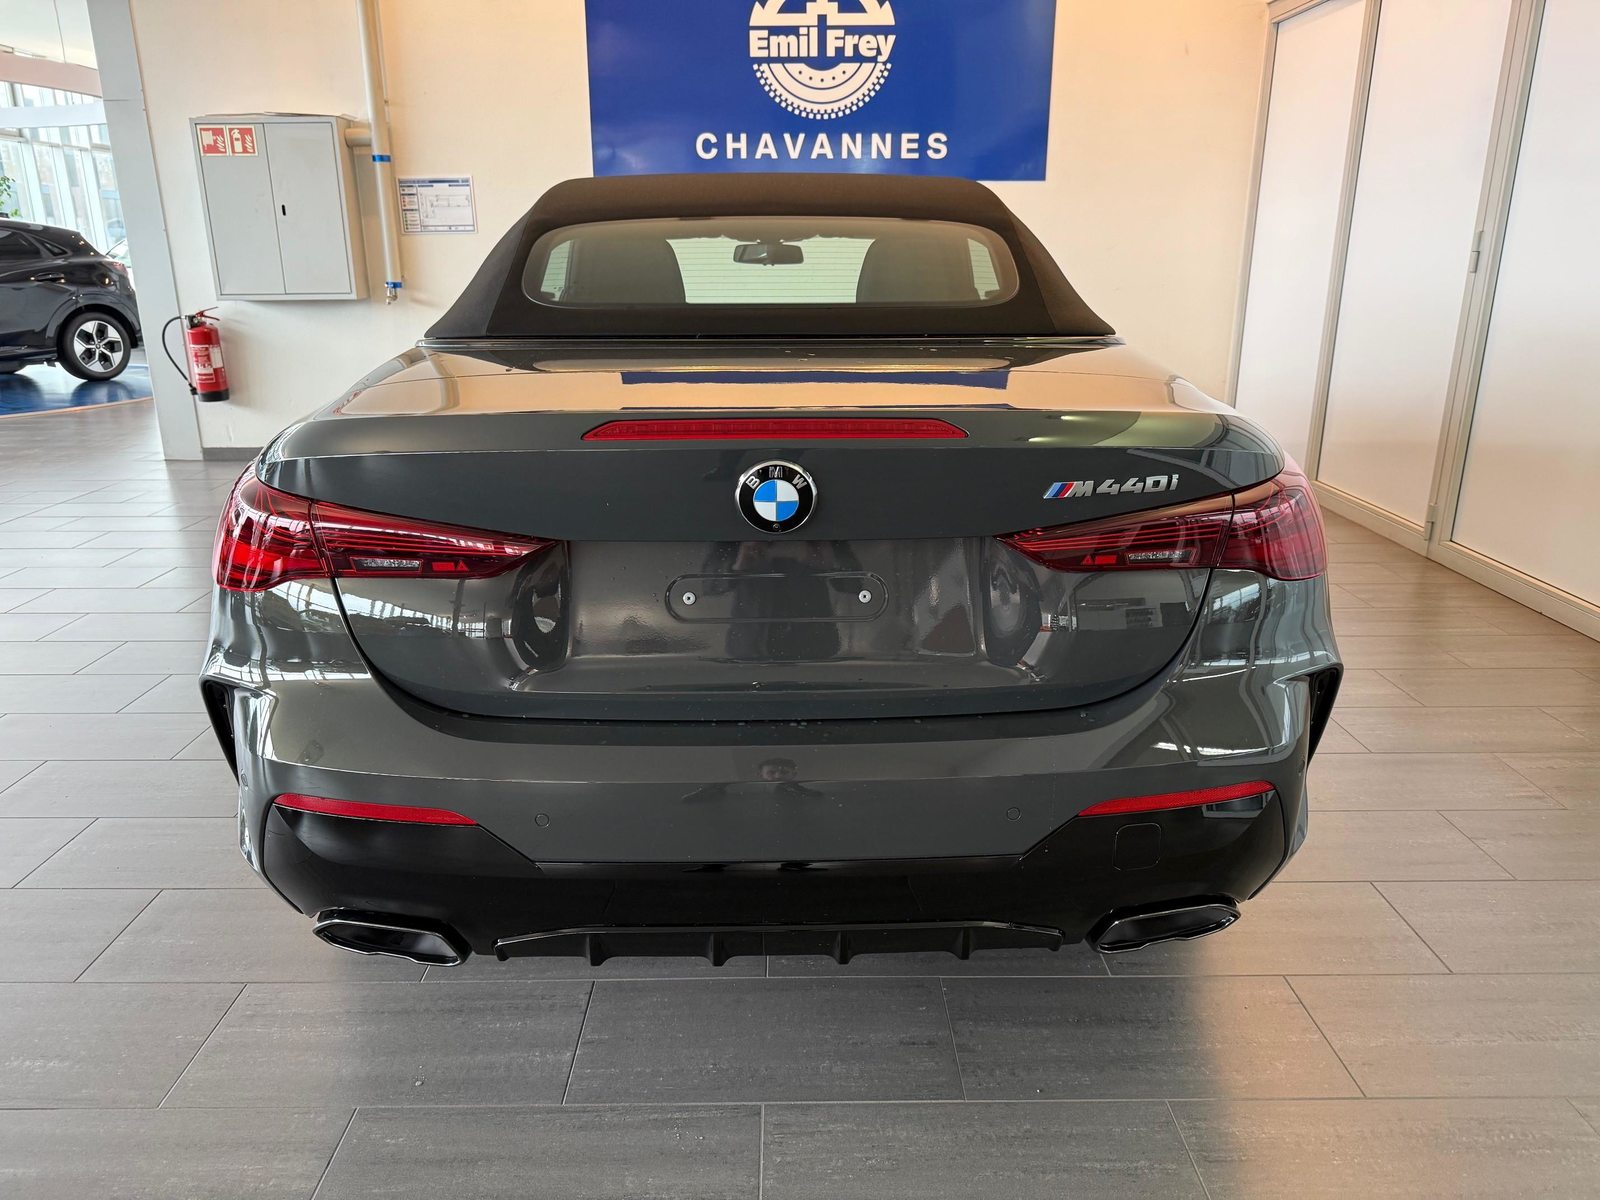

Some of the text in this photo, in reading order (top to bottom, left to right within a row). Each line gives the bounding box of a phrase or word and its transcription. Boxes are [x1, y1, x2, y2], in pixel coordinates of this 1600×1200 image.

[749, 26, 897, 62] Emil Frey
[695, 132, 949, 160] CHAVANNES
[745, 466, 808, 490] BMW
